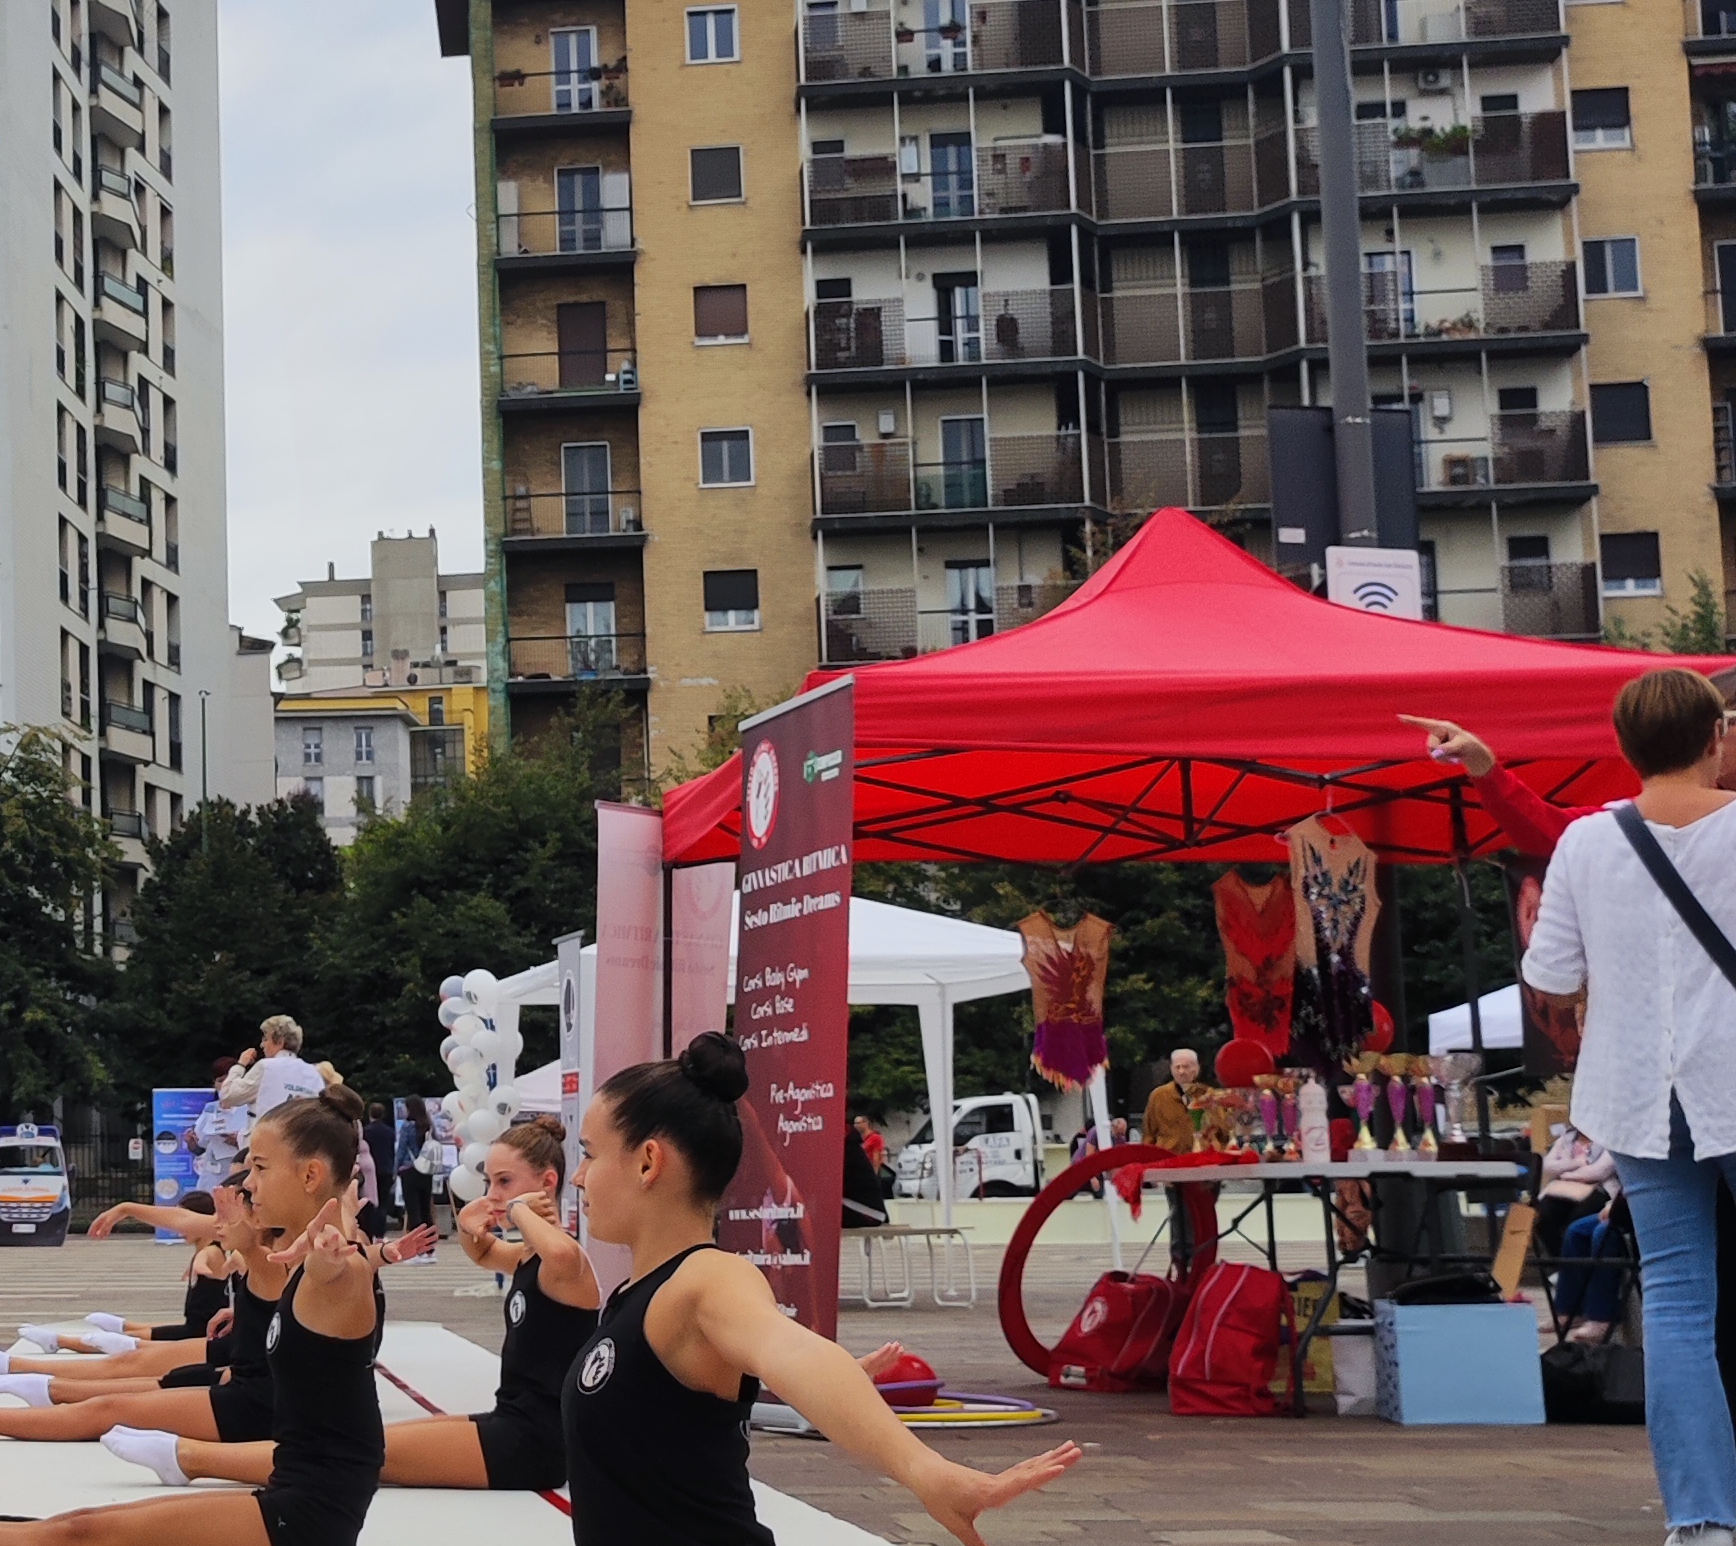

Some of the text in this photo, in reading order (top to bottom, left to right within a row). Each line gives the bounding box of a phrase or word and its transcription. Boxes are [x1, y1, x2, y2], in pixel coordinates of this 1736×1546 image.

[742, 844, 849, 894] GINNASTICA RITMICA
[744, 891, 842, 931] Sesto Ritmic Dreams
[743, 963, 810, 993] Corsi Baby Gym
[751, 994, 795, 1020] Corsi Base
[739, 1022, 810, 1052] Corsi Intermedi
[777, 1113, 824, 1147] Agonistica
